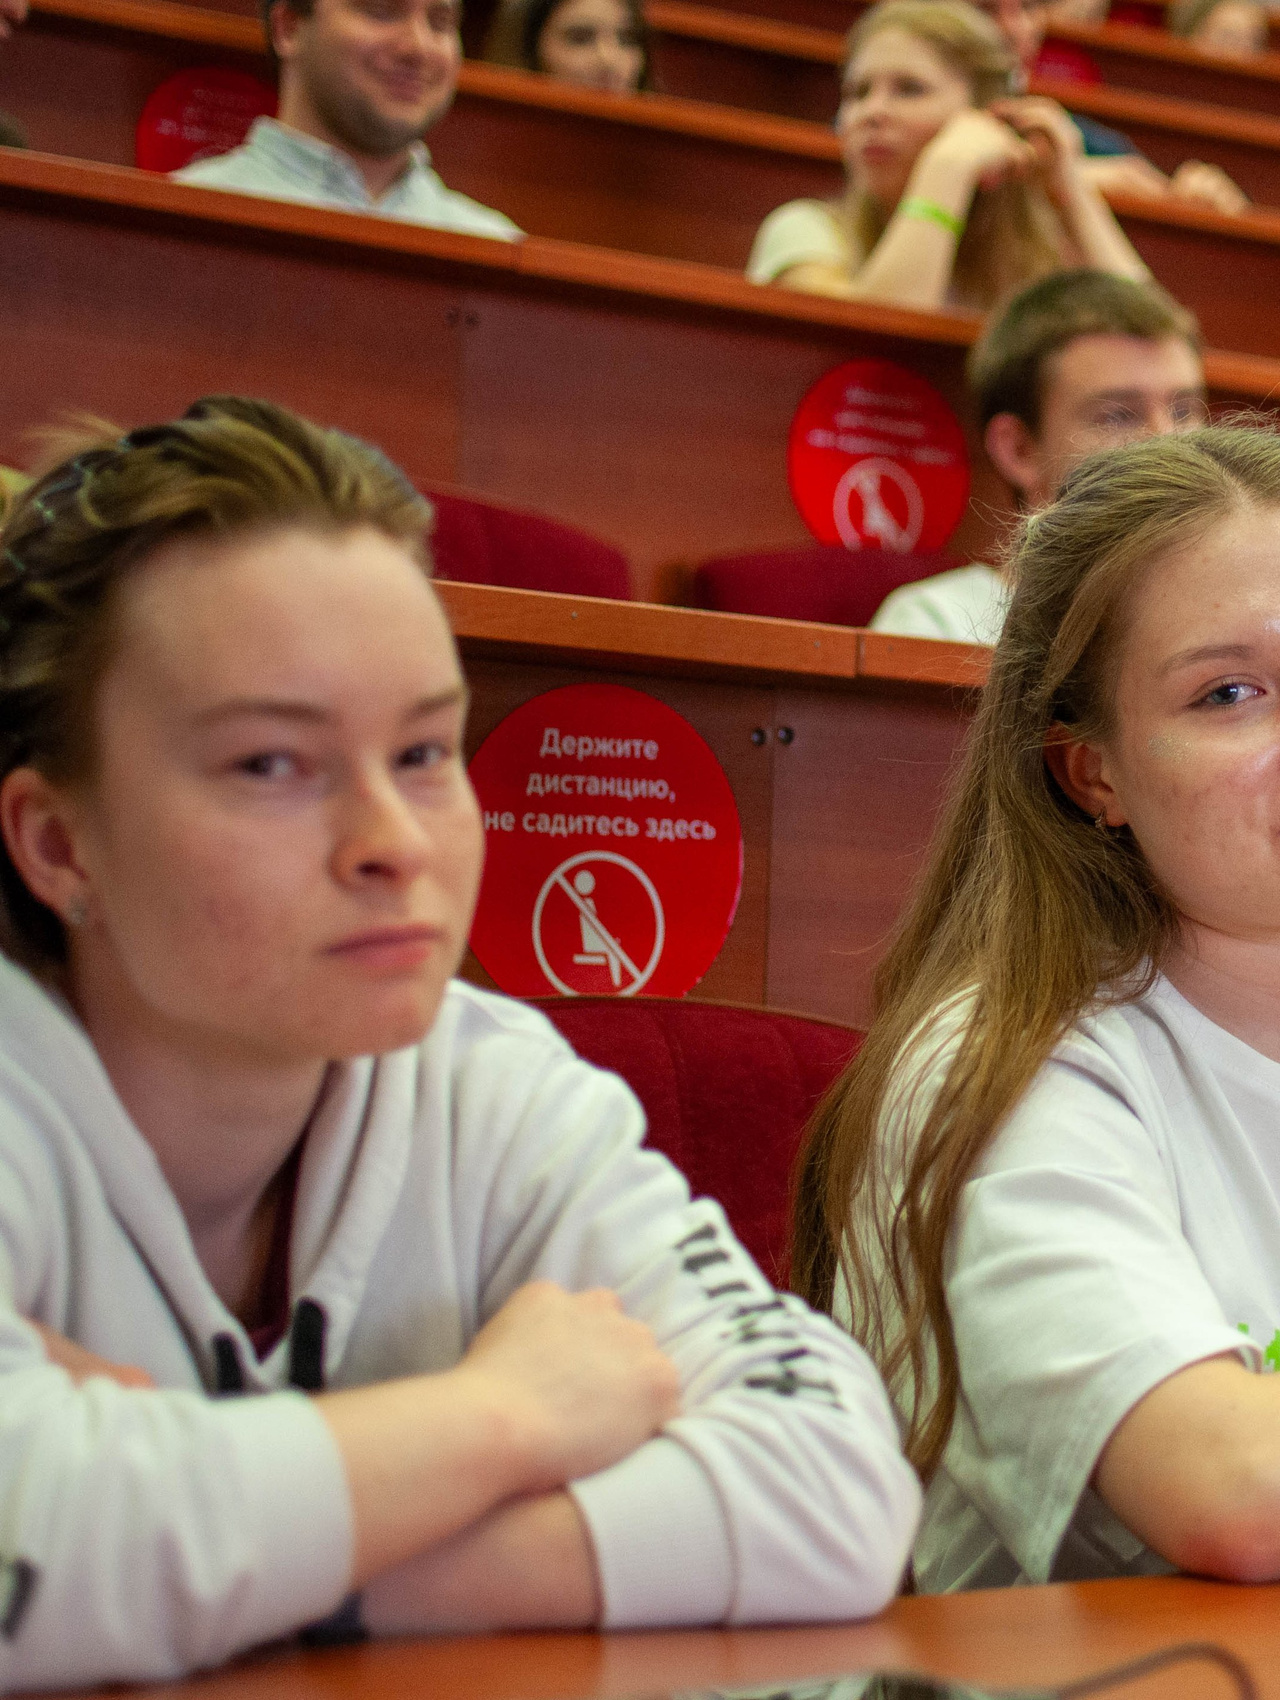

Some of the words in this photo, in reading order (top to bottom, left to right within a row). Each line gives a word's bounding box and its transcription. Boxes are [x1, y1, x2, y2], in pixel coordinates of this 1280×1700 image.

[541, 728, 659, 759] Держите
[527, 773, 676, 802] дистанцию,
[484, 810, 515, 830] не
[522, 812, 640, 837] садитесь
[645, 817, 716, 841] здесь
